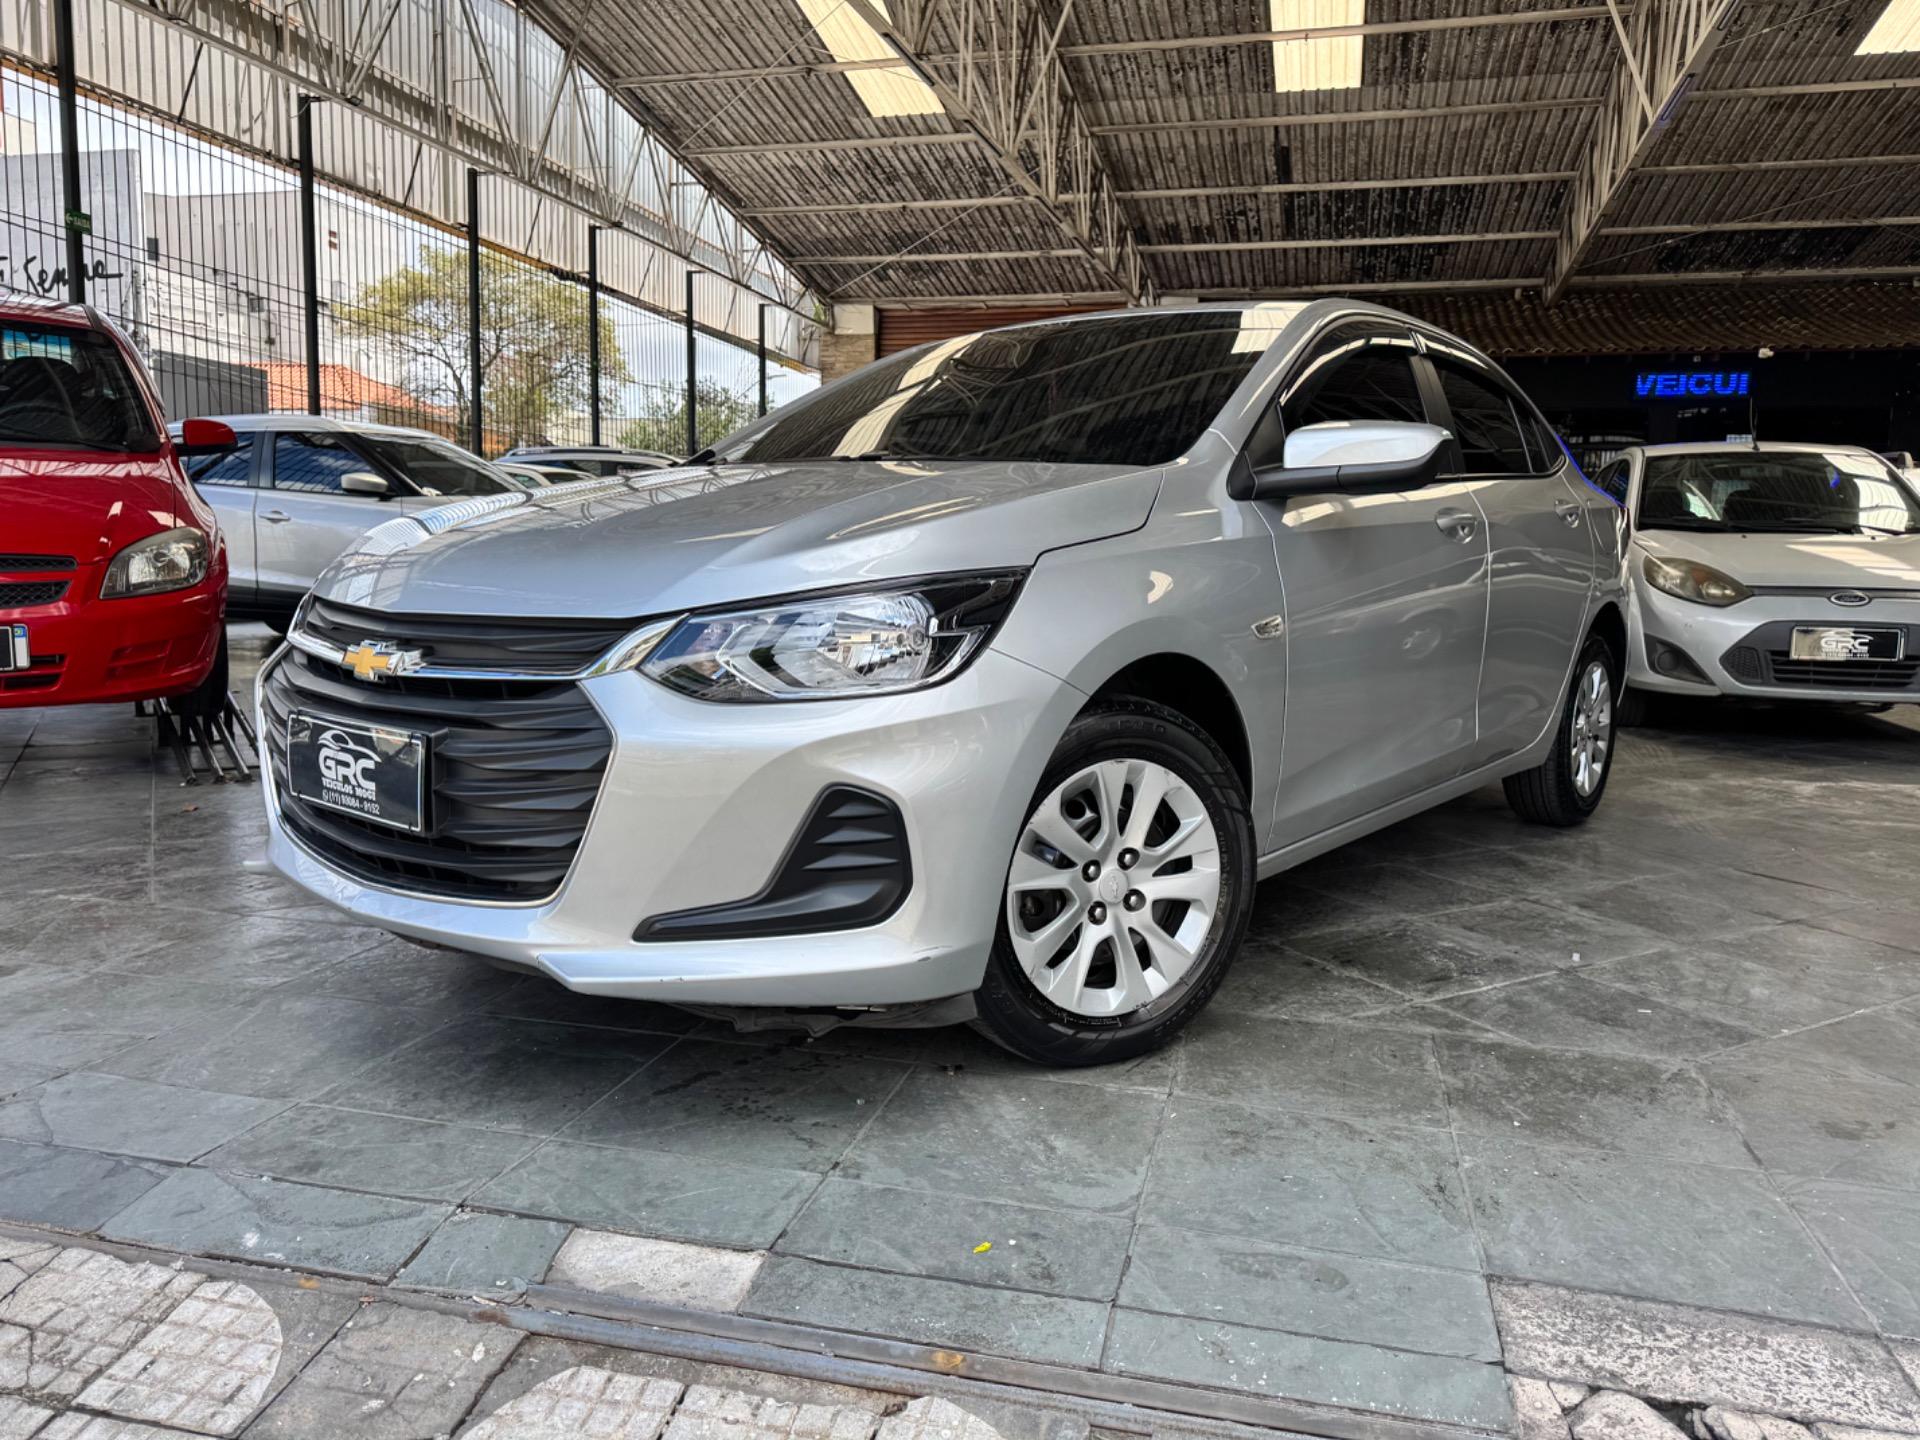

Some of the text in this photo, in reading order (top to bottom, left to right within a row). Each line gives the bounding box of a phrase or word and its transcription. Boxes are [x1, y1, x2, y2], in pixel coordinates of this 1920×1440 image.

[1821, 637, 1869, 651] GRC
[319, 747, 376, 790] GRC
[321, 777, 353, 794] VEICULOS
